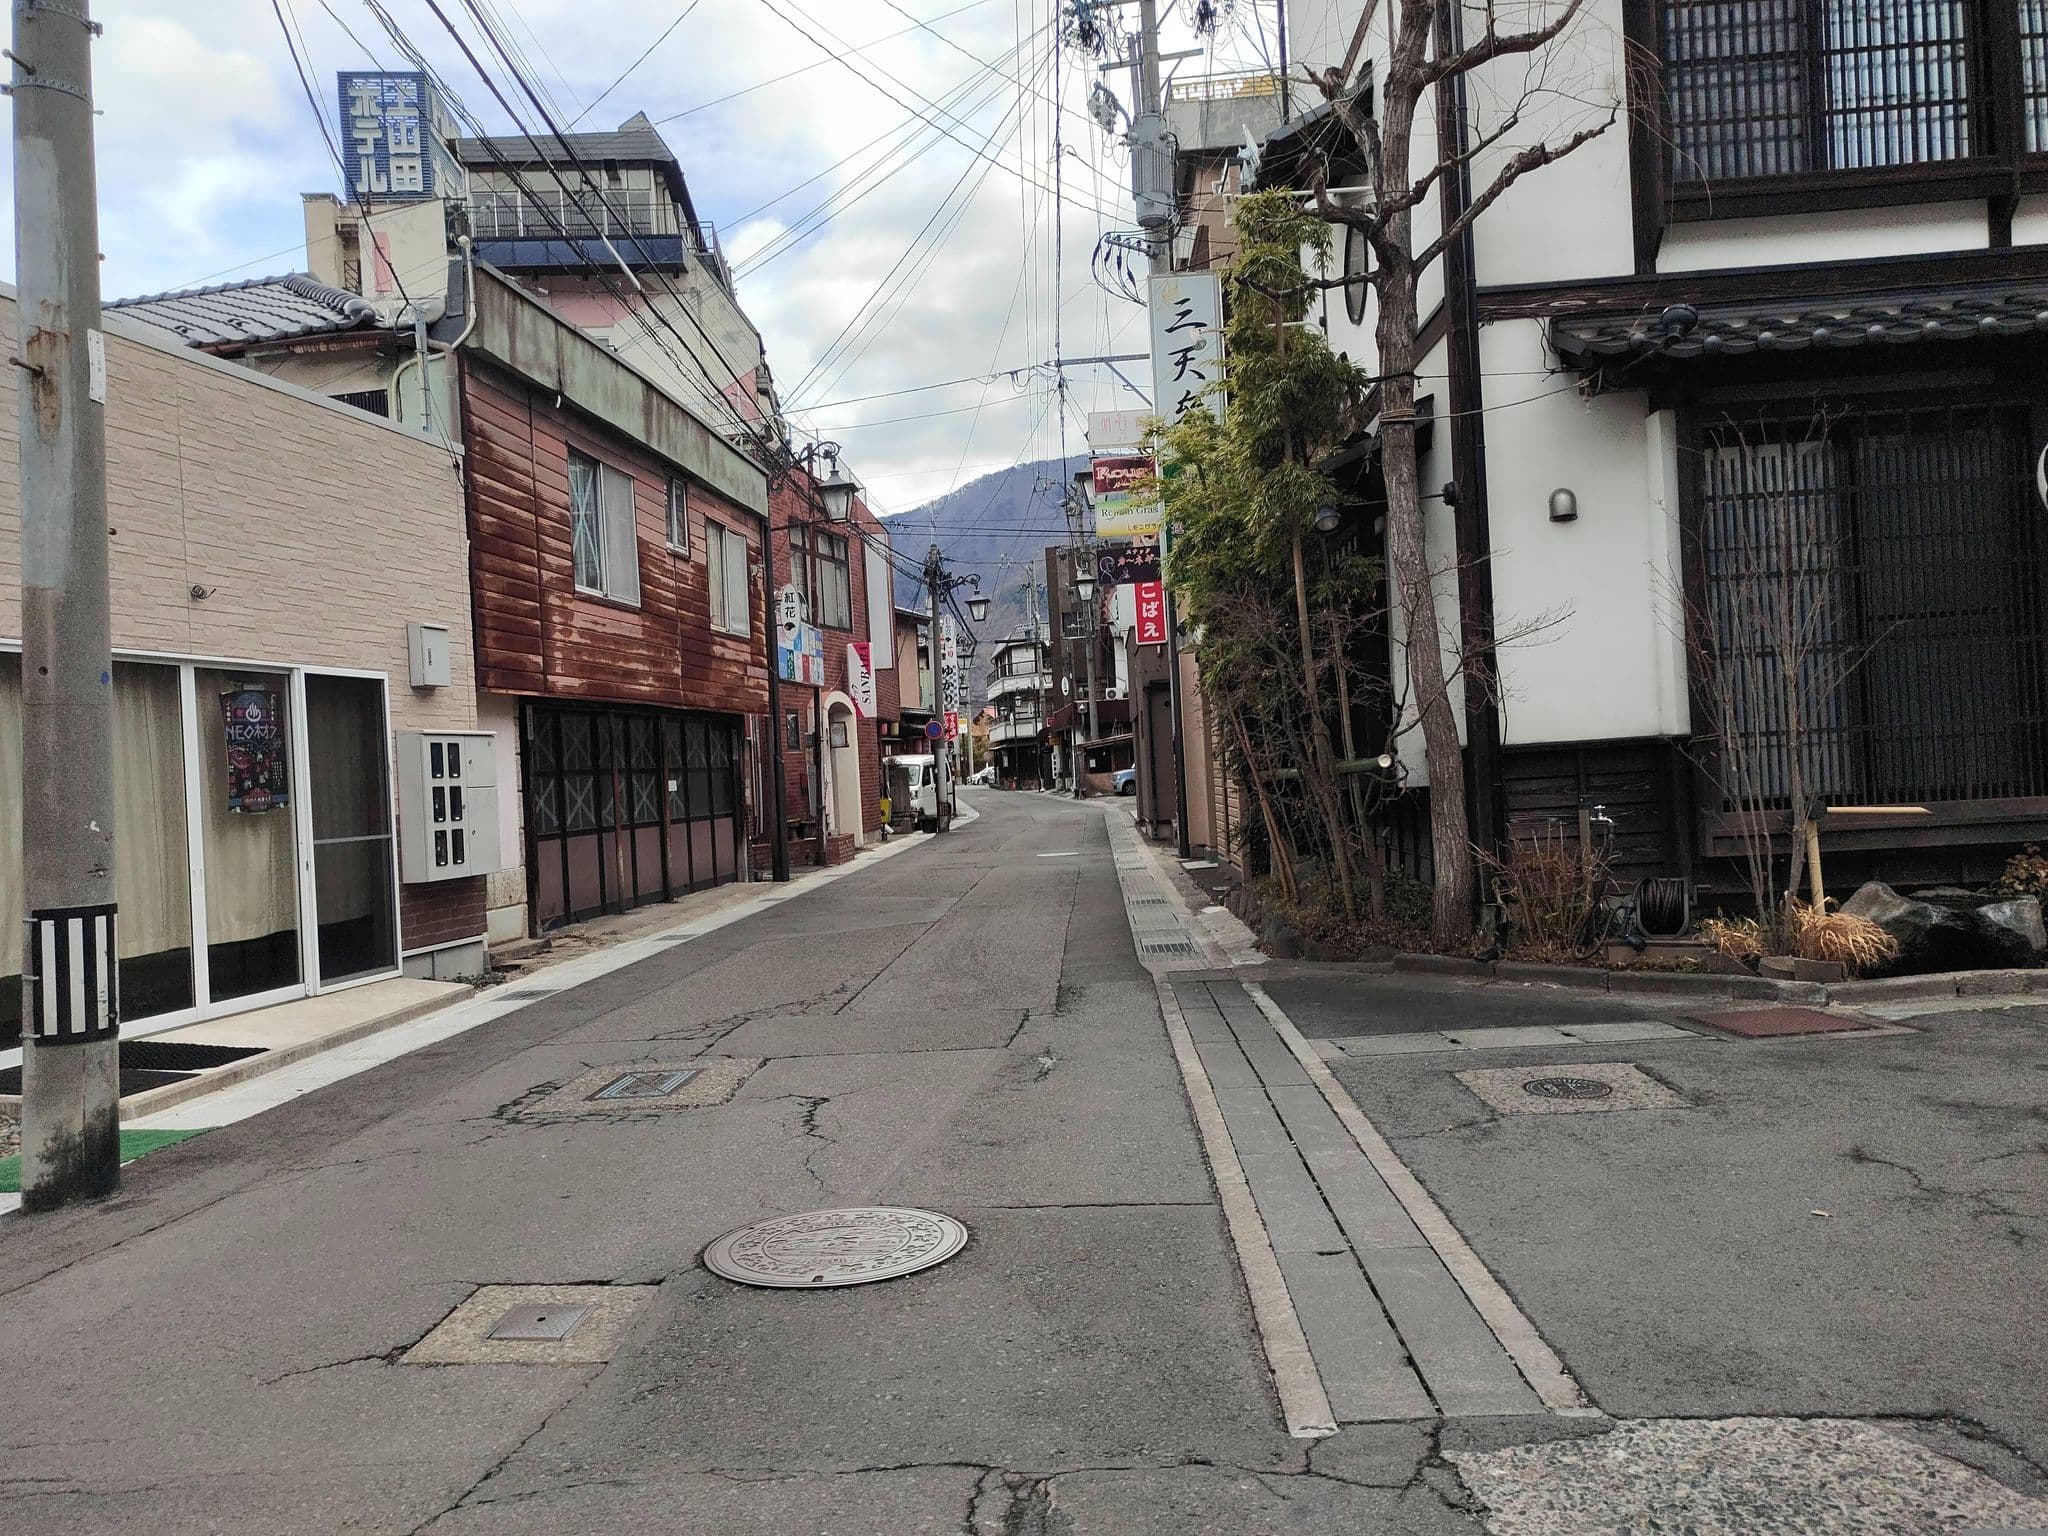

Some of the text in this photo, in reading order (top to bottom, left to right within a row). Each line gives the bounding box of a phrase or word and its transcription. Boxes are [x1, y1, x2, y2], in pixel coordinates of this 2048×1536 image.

[350, 82, 387, 192] ホテル
[784, 592, 796, 619] 紅花
[1142, 582, 1159, 638] こばえ
[942, 665, 954, 706] ゆかり
